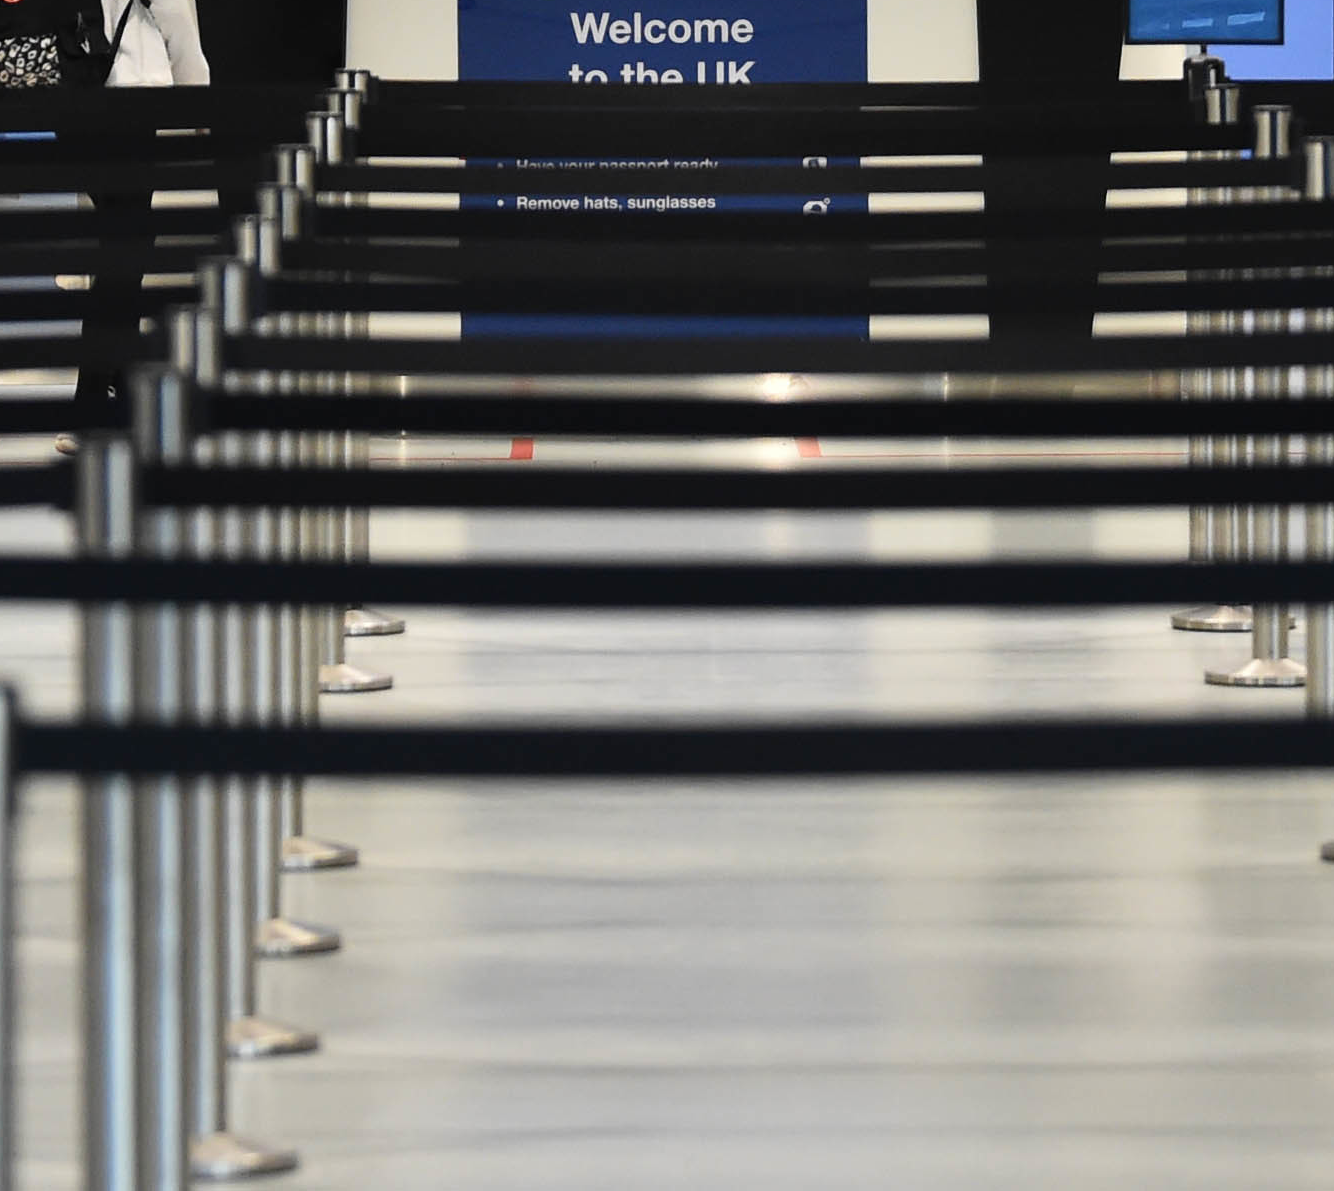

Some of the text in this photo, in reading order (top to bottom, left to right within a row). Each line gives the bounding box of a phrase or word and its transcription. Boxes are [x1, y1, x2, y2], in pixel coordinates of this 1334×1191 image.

[570, 11, 754, 45] Welcome
[568, 60, 756, 84] to the UK
[516, 159, 555, 169] Have
[673, 157, 719, 169] ready
[516, 195, 717, 213] Remove hats, sunglasses
